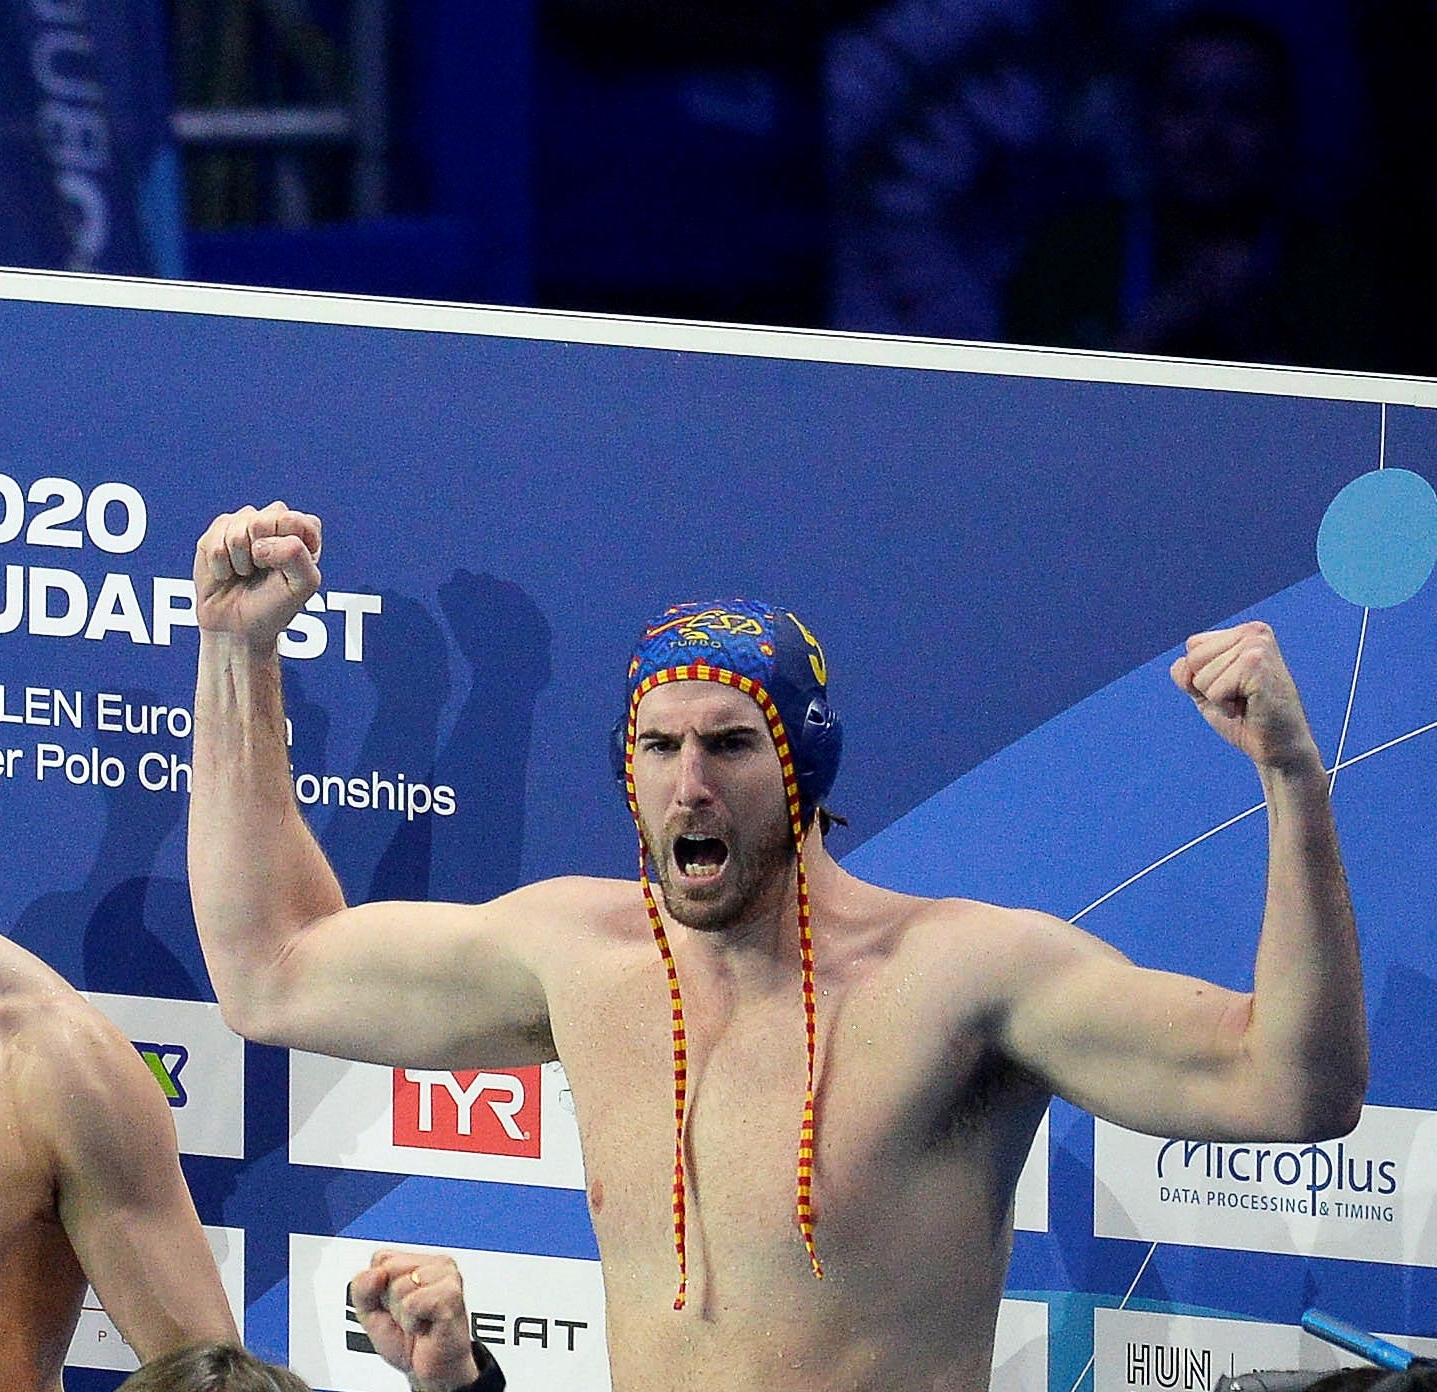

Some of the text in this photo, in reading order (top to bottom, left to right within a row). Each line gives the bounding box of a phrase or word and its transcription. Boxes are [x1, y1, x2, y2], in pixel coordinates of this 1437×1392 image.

[36, 744, 125, 790] Polo
[405, 1069, 529, 1141] TYR
[1157, 1138, 1397, 1217] Microplus
[1159, 1186, 1394, 1222] DATA PROCESSING & TIMING
[471, 1312, 588, 1352] EAT
[1127, 1342, 1212, 1392] HUN
